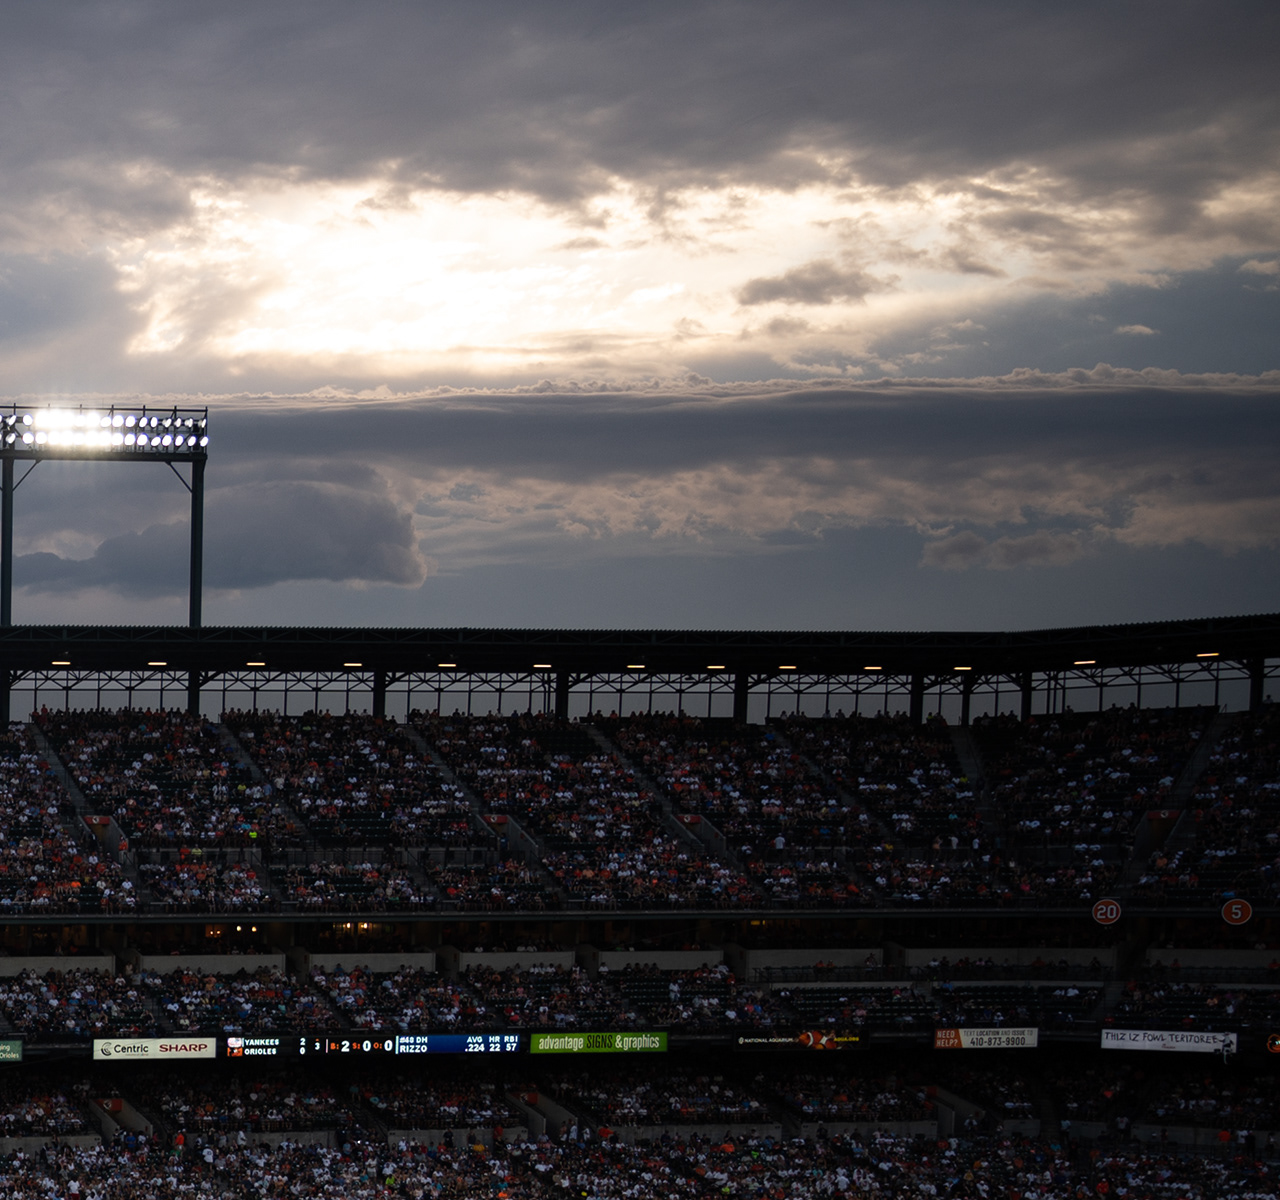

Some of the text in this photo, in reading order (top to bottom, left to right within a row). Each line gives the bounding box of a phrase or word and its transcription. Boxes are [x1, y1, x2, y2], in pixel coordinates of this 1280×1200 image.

[1096, 904, 1117, 919] 20
[1231, 904, 1242, 919] 5
[937, 1030, 955, 1038] NEED
[1104, 1031, 1126, 1041] THIZ
[1128, 1032, 1139, 1042] IZ
[1142, 1032, 1165, 1042] FOWL
[244, 1037, 306, 1046] YANKEES 2
[314, 1041, 320, 1051] 3
[340, 1040, 350, 1052] 2
[362, 1040, 371, 1052] 0
[384, 1040, 393, 1052] 0
[539, 1035, 583, 1051] advantage
[586, 1034, 613, 1049] SIGNS
[936, 1039, 958, 1047] HELP?
[970, 1037, 1026, 1047] 410-873-9900
[114, 1043, 208, 1053] Centric SHARP
[244, 1047, 305, 1055] ORIOLES 0
[400, 1044, 428, 1053] RIZZO
[465, 1043, 517, 1052] .224 22 57
[0, 1051, 19, 1059] Orioles
